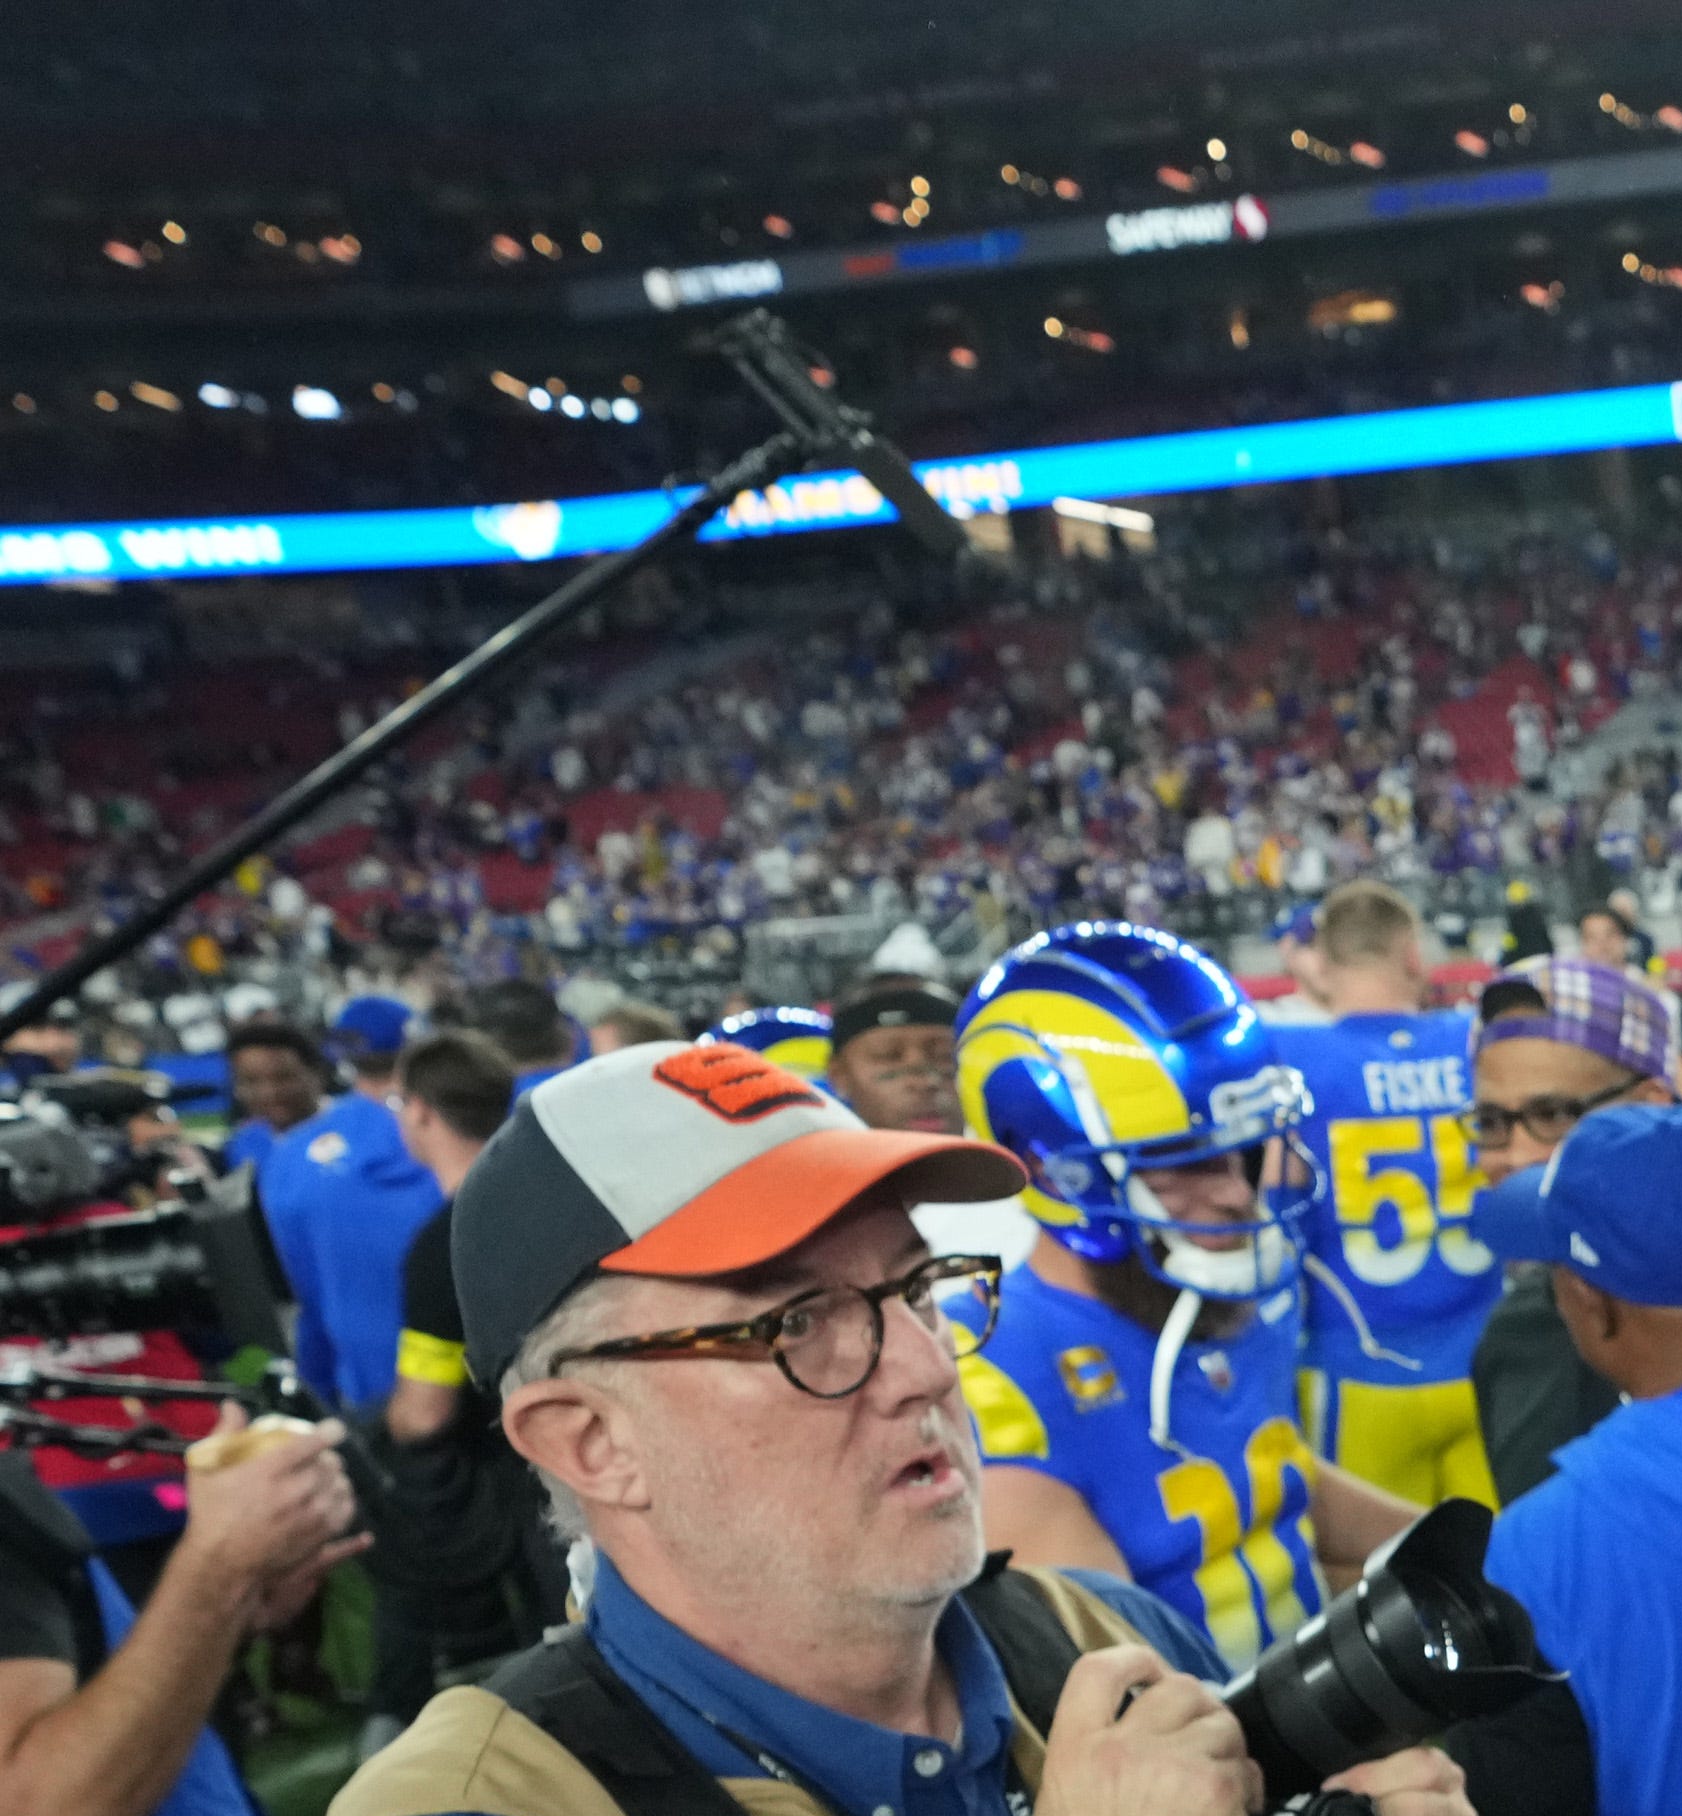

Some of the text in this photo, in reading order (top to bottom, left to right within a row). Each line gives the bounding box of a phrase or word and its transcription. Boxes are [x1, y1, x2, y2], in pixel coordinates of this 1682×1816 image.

[0, 523, 284, 574] MS WIN!
[1362, 1055, 1474, 1114] FISKE
[1328, 1114, 1495, 1288] 55
